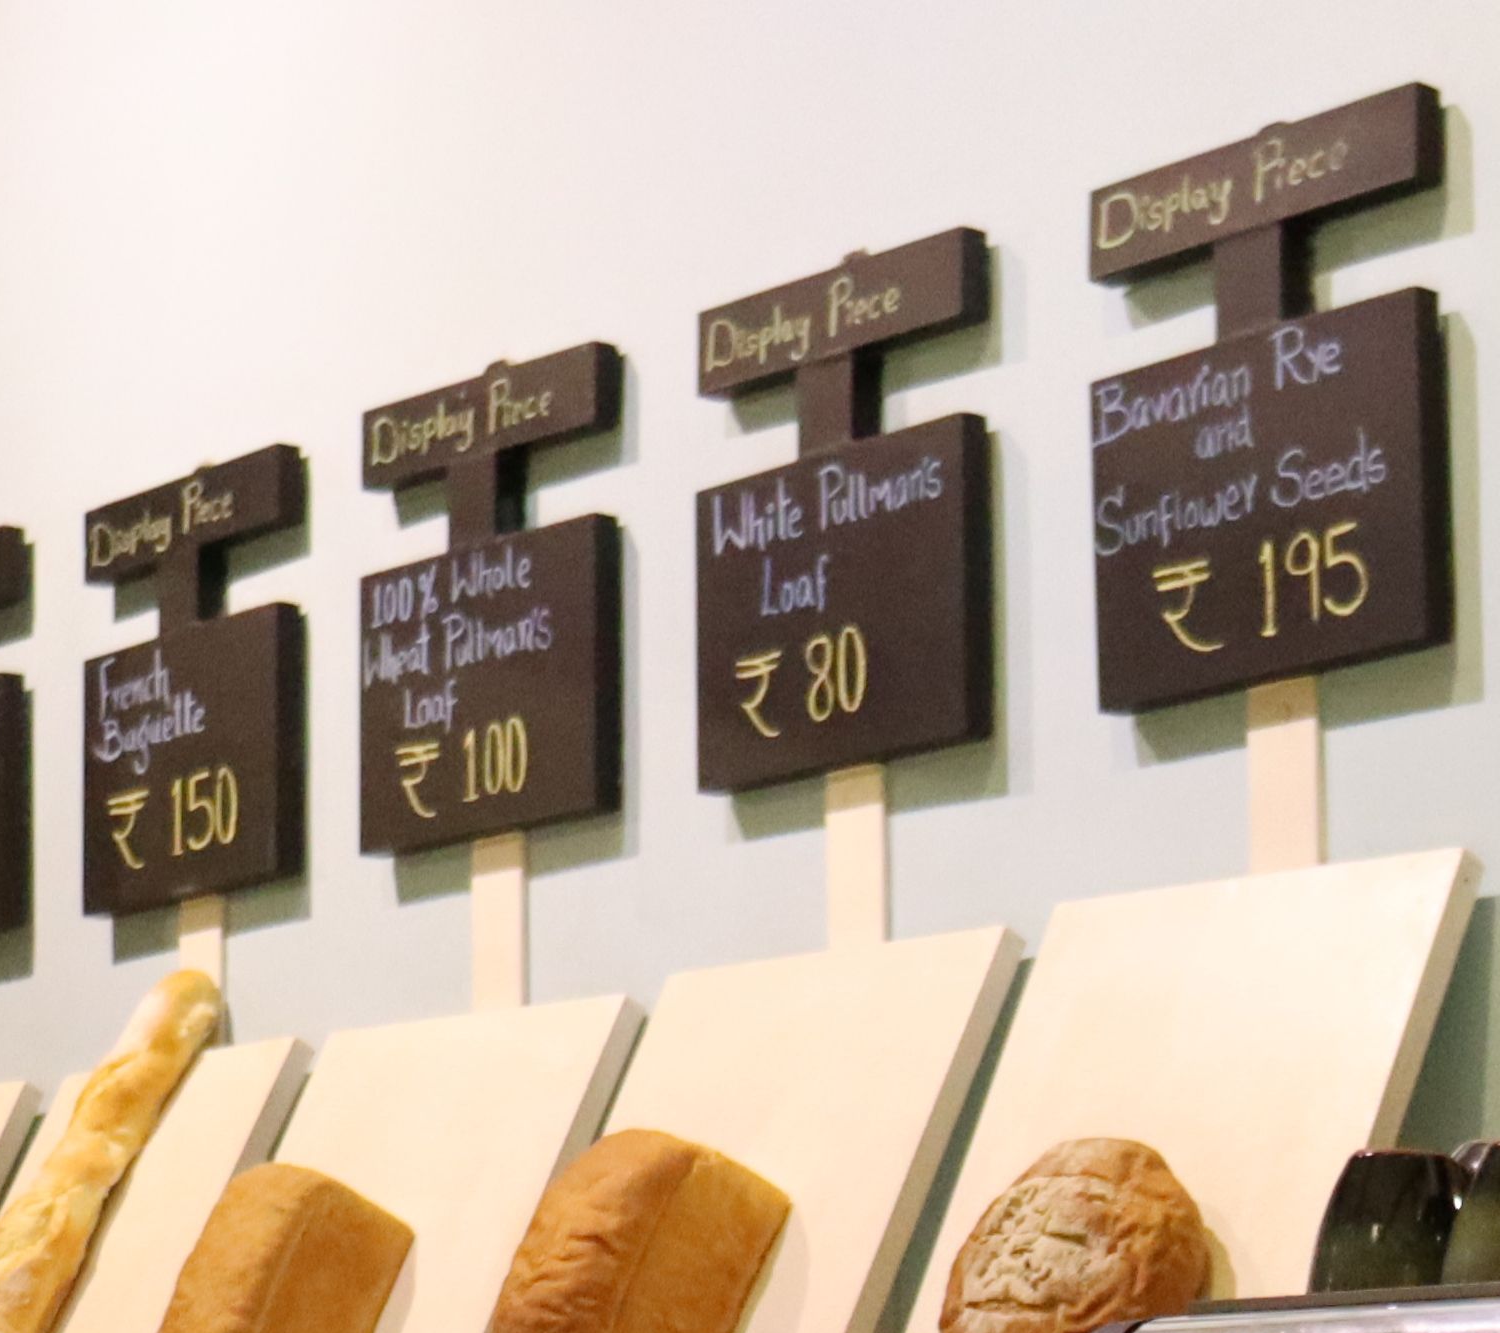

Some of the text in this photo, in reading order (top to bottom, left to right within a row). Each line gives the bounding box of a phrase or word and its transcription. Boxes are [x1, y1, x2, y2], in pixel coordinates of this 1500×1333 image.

[1096, 136, 1350, 250] Display Piece
[704, 277, 902, 373] Display Piece
[1091, 324, 1343, 448] Bavarian Rye
[371, 402, 477, 466] Display
[1197, 407, 1254, 460] and
[712, 456, 942, 556] White Pullman's
[1094, 429, 1389, 556] Sunflower Seeds
[90, 511, 172, 567] Display
[372, 546, 532, 629] 100% Whole
[761, 555, 830, 617] Loaf
[1152, 522, 1370, 653] ₹ 195
[99, 648, 171, 724] French
[363, 624, 431, 690] Wheat
[734, 626, 868, 738] ₹ 80
[95, 689, 206, 775] Baguette
[404, 679, 459, 734] Loaf
[395, 716, 528, 818] ₹ 100
[107, 765, 239, 869] ₹ 150
